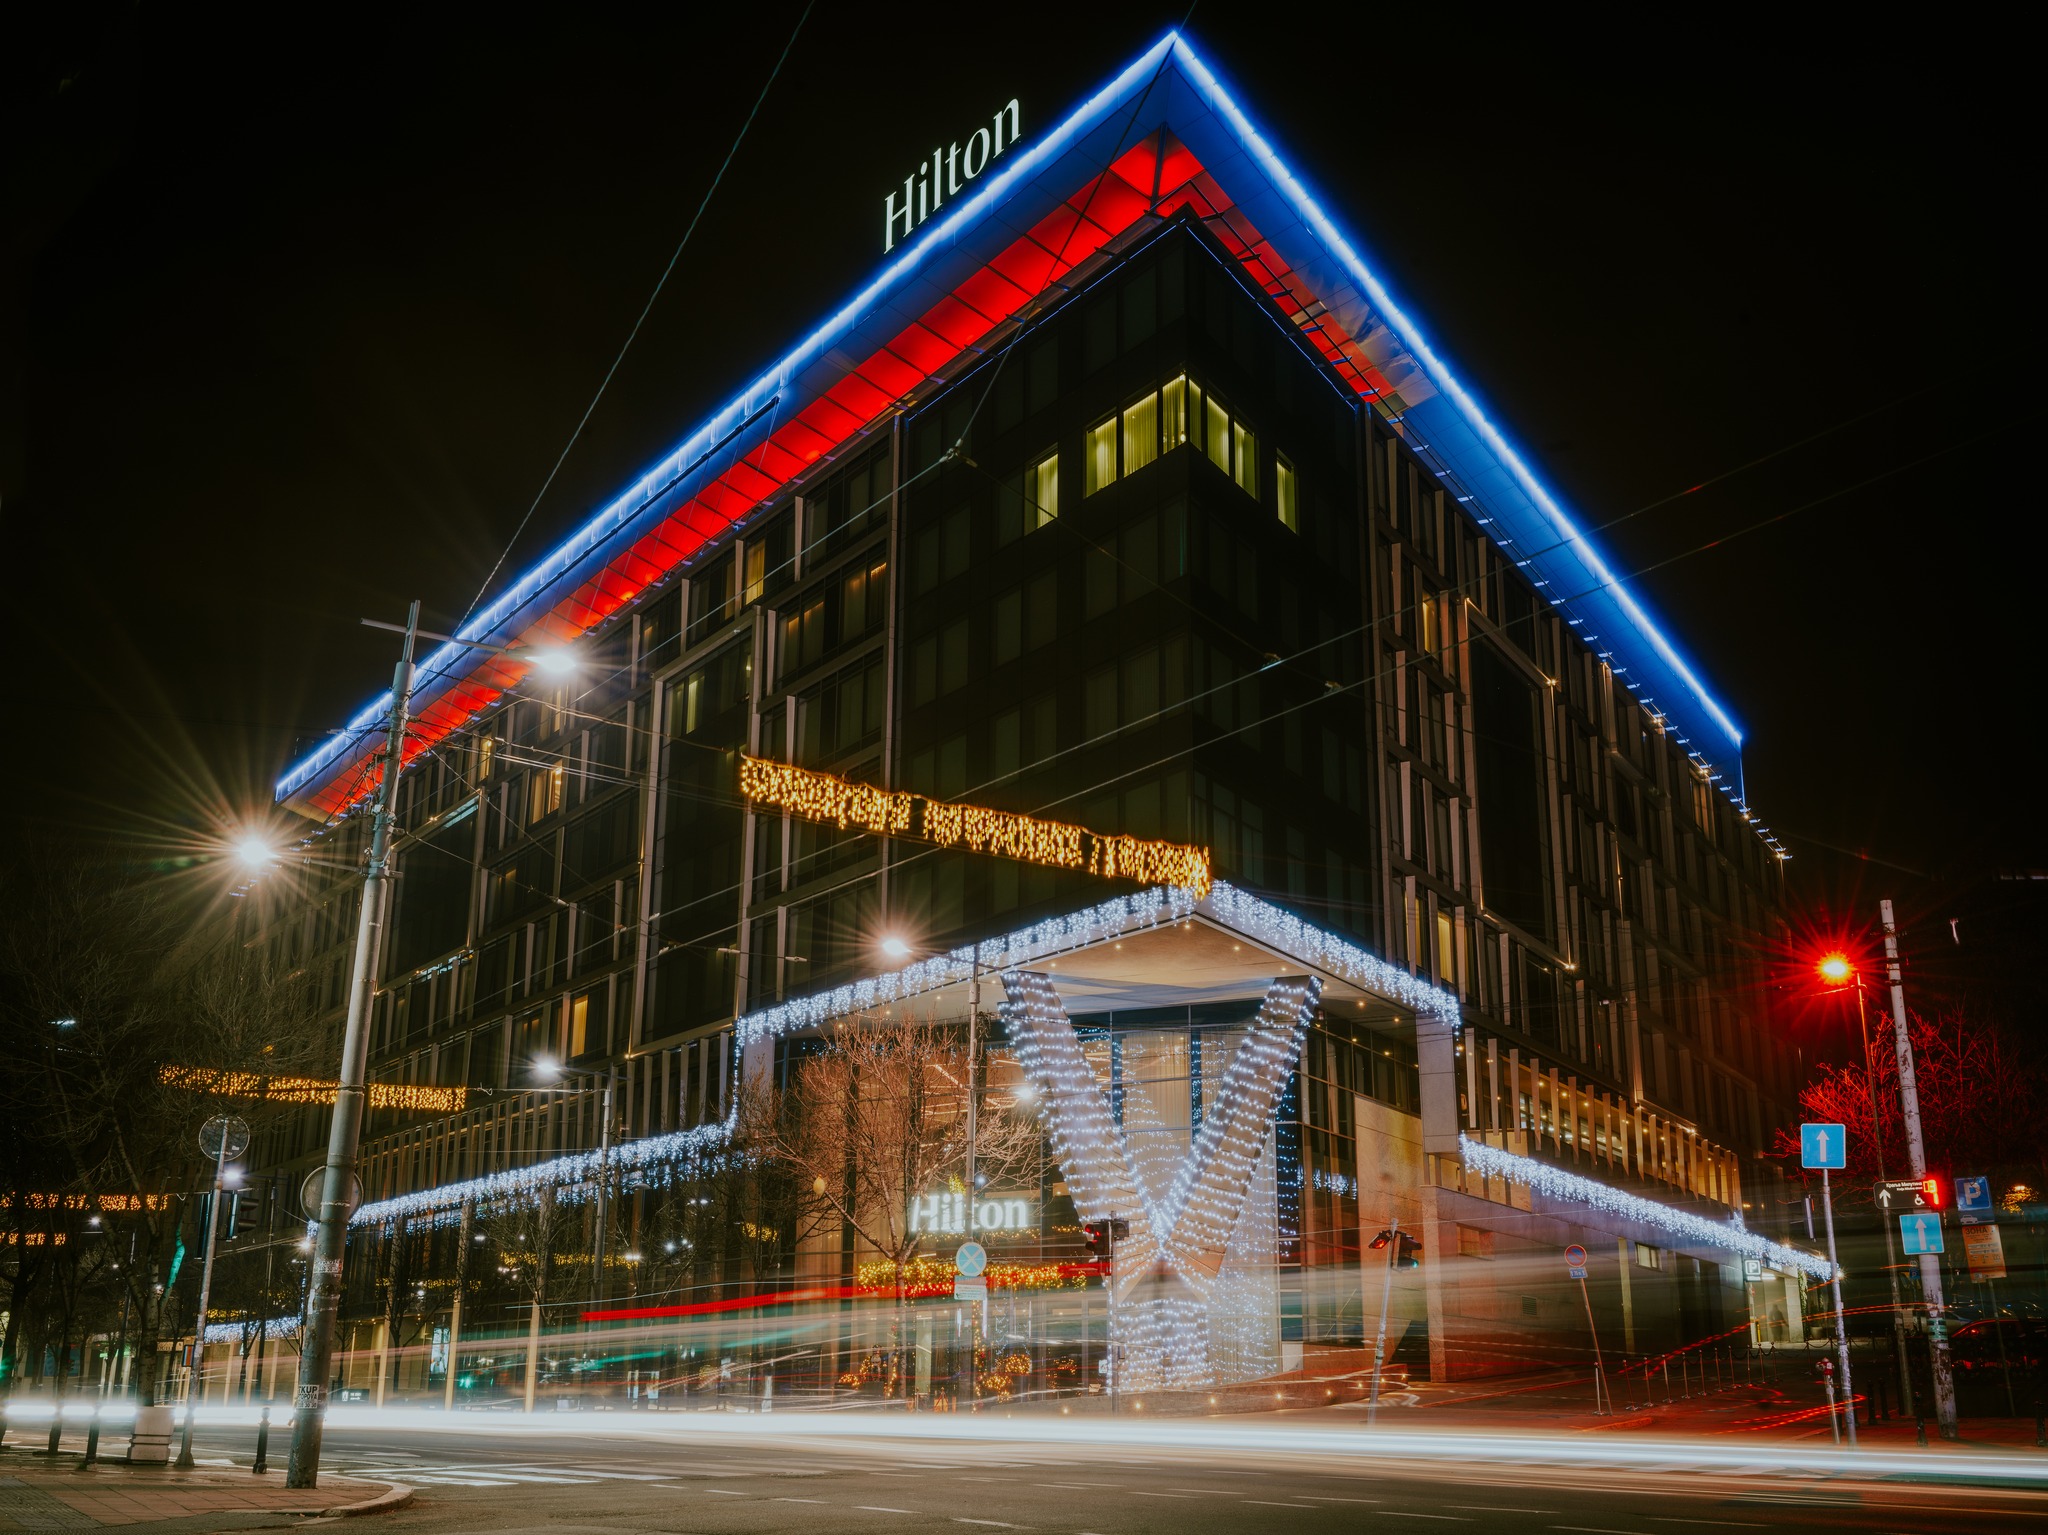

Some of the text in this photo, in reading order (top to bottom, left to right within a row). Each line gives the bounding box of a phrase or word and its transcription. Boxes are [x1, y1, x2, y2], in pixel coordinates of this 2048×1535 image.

[883, 98, 1022, 255] Hilton
[1963, 1181, 1982, 1206] P
[1965, 1226, 1988, 1235] ЗОНА
[1748, 1262, 1758, 1273] P
